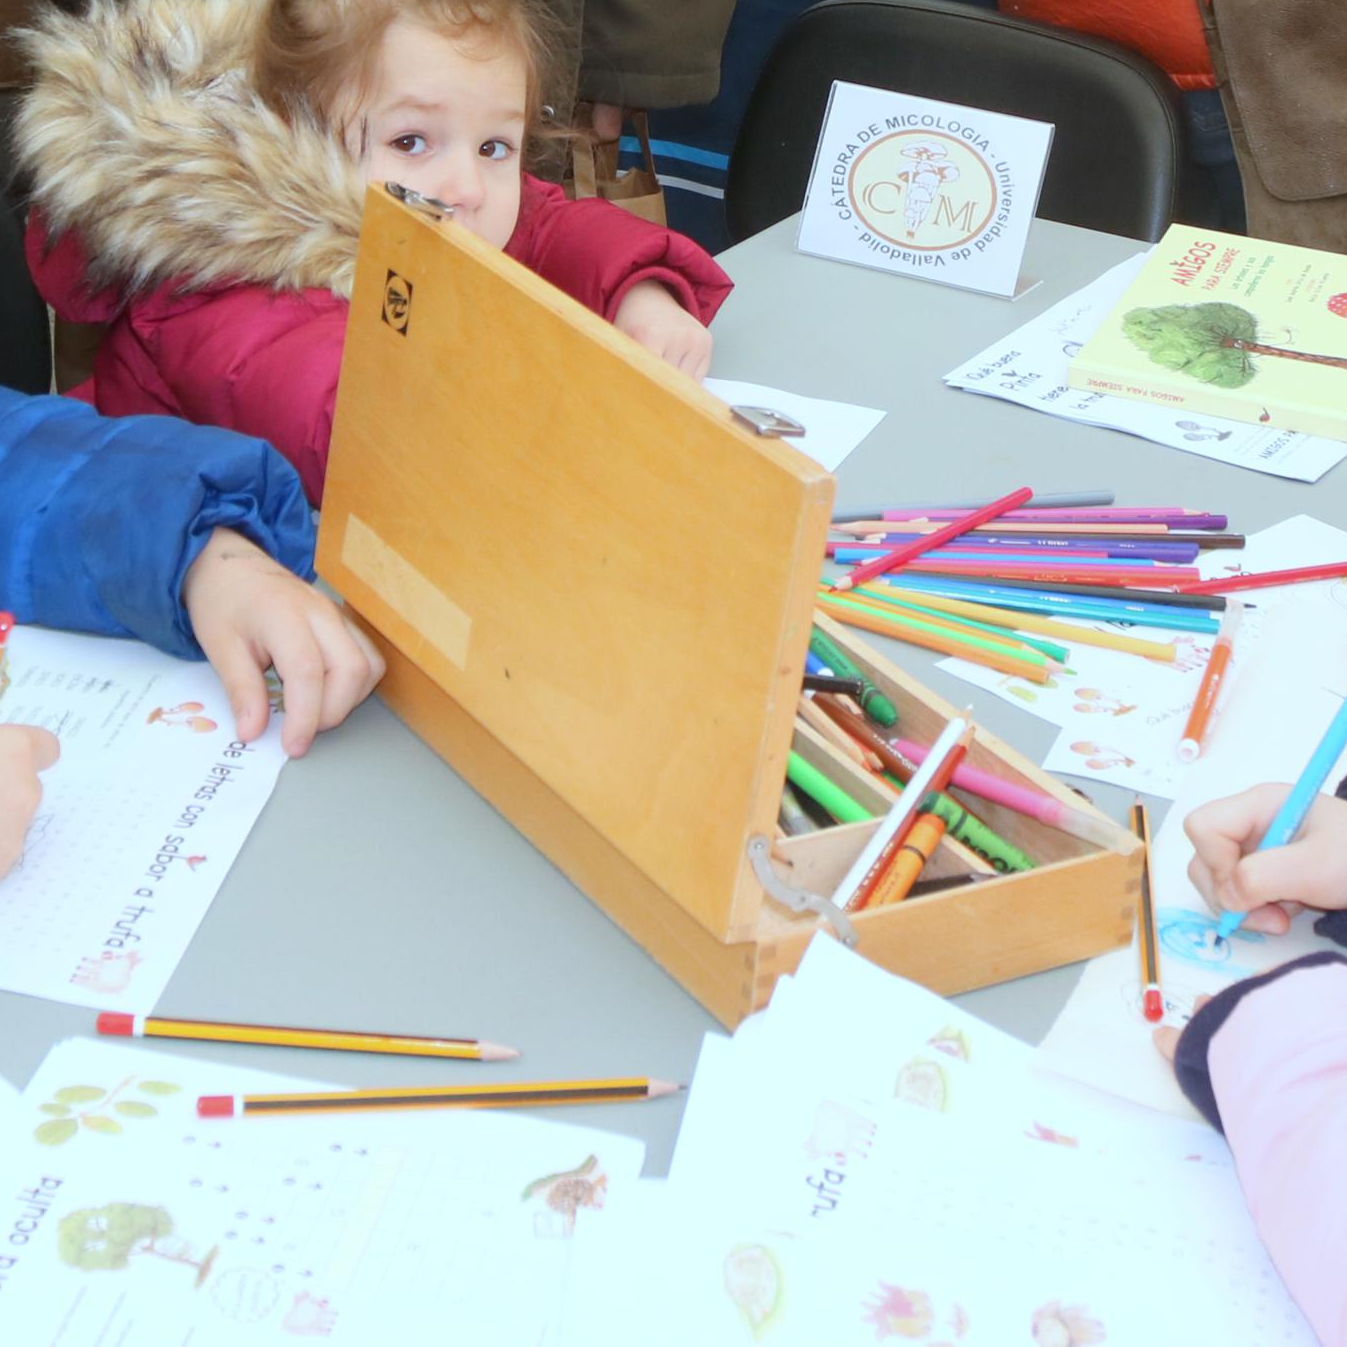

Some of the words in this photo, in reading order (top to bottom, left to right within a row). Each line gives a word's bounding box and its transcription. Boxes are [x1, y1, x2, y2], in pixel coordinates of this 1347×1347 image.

[857, 122, 884, 144] DE
[830, 142, 860, 221] CÁTEDRA
[976, 160, 1014, 248] Universidad
[858, 230, 946, 267] Valladolid
[951, 247, 973, 263] de
[1170, 241, 1216, 287] AMIGOS
[1213, 247, 1241, 275] SIEMPRE
[1087, 378, 1123, 392] SIEMPRE
[1151, 390, 1186, 403] AMIGOS
[222, 740, 256, 759] de
[193, 762, 245, 802] letras
[172, 804, 205, 830] con
[144, 833, 190, 883] sabor
[133, 887, 155, 899] a
[103, 905, 155, 949] trufa
[8, 1176, 64, 1246] oculta
